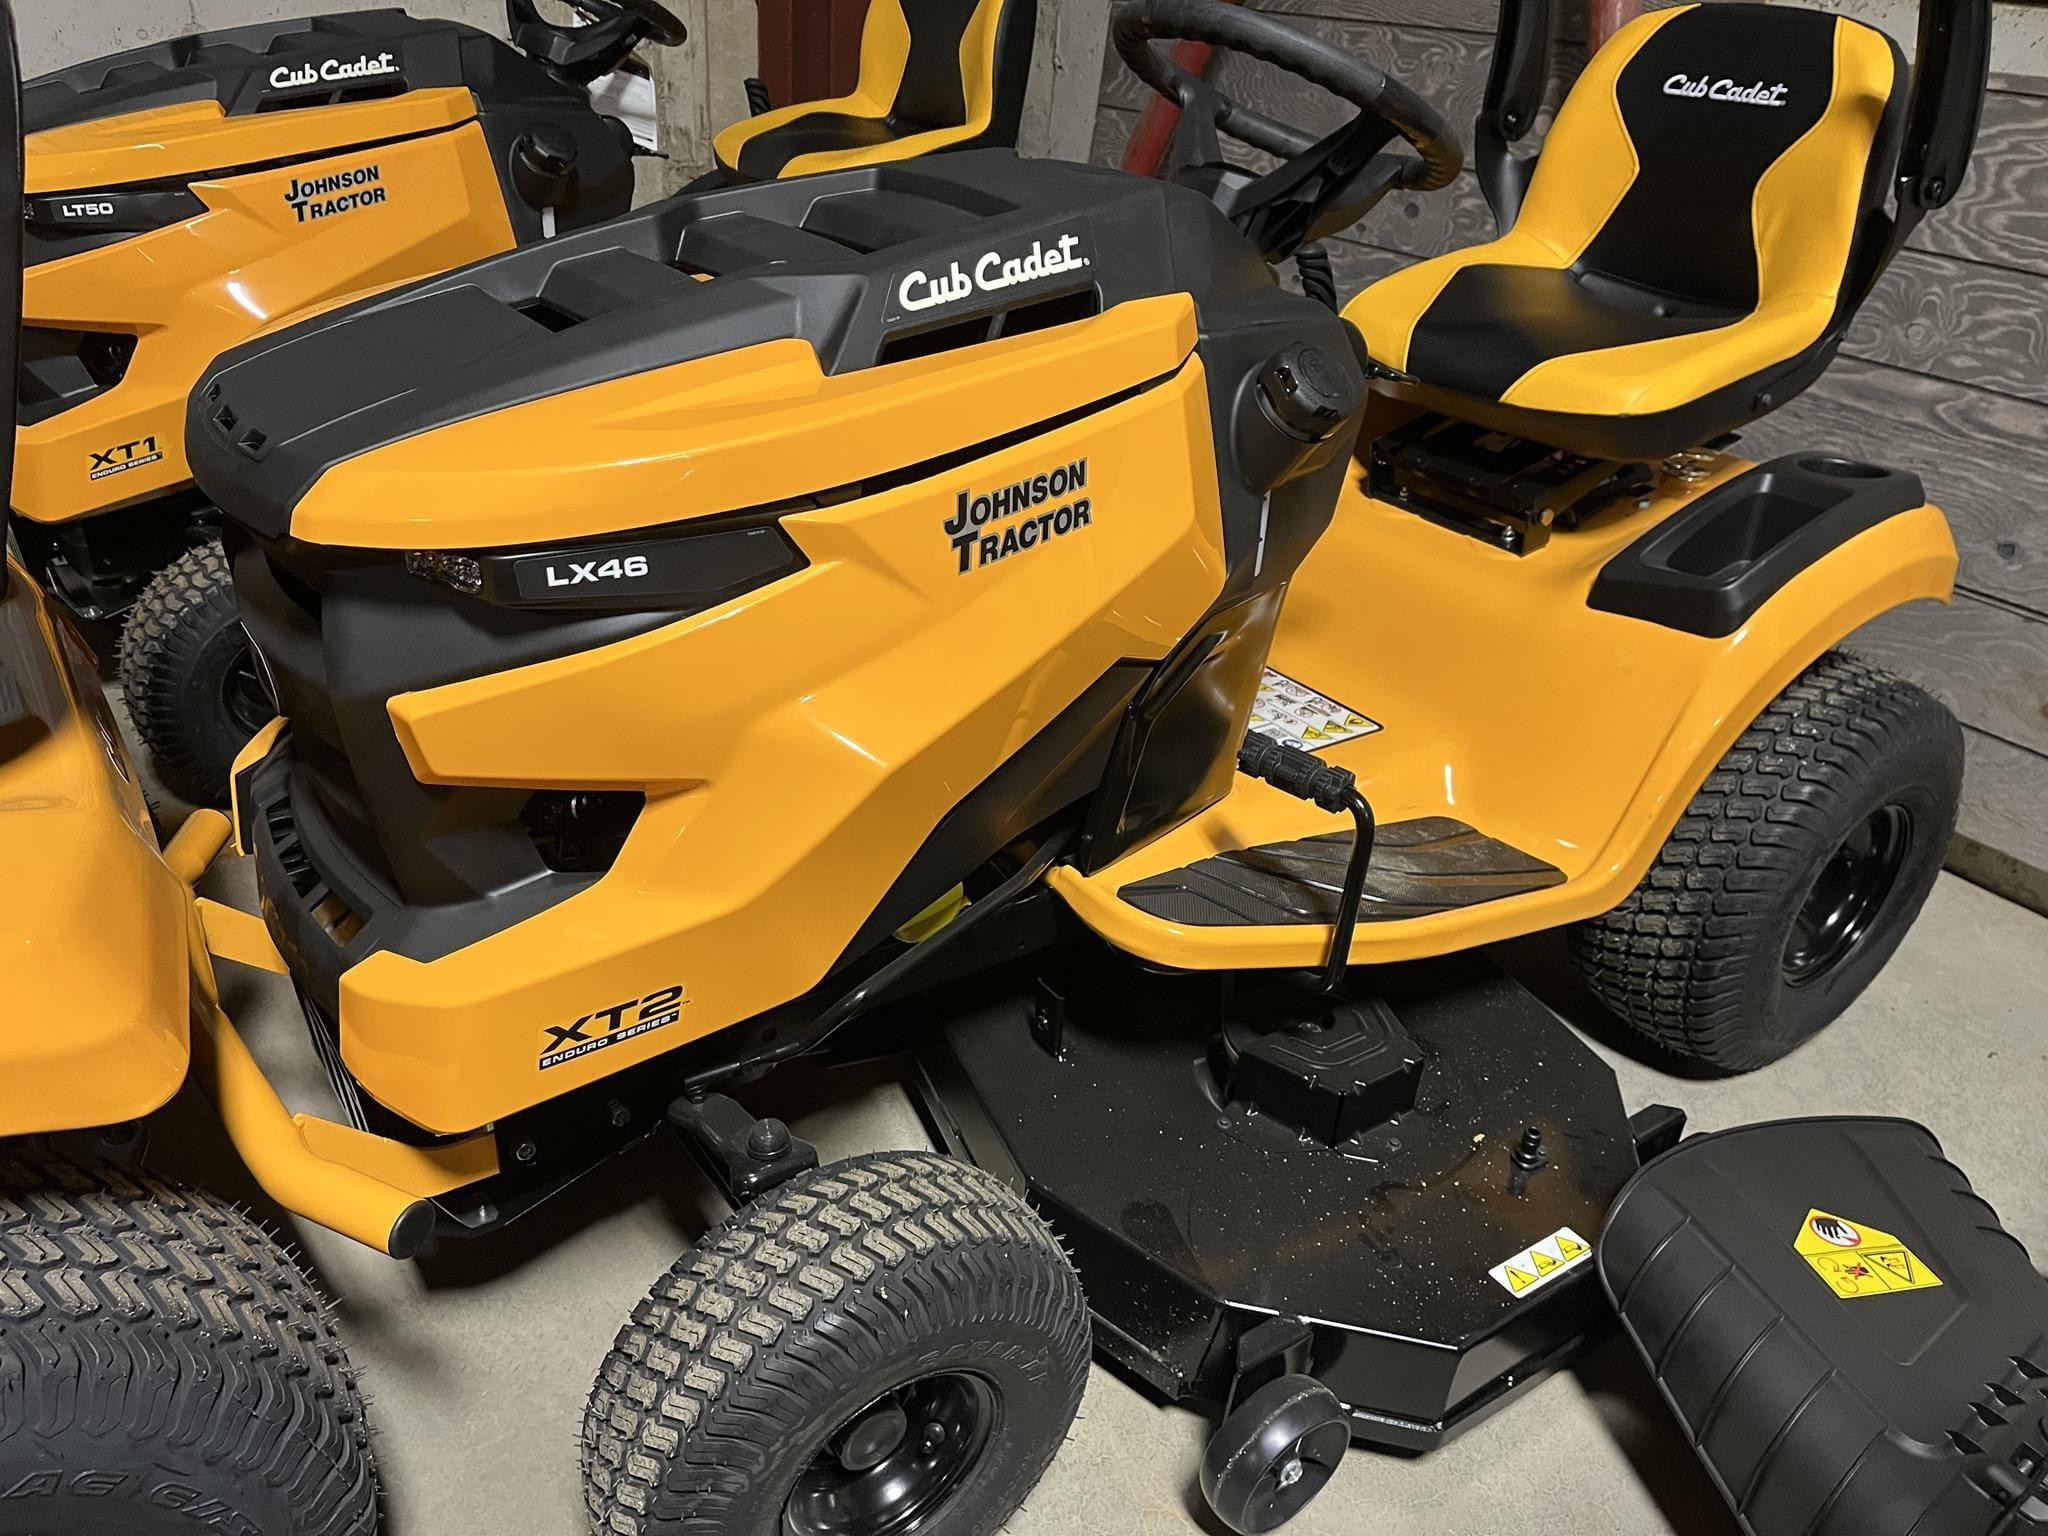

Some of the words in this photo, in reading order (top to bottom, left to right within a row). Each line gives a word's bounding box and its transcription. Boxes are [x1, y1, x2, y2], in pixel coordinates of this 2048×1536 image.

[269, 64, 319, 89] Cub
[320, 52, 395, 81] Cadet
[1663, 74, 1709, 98] Cub
[1708, 79, 1788, 107] Cadet
[284, 165, 380, 203] JOHNSON
[62, 202, 114, 217] LT50
[291, 187, 387, 223] TRACTOR
[899, 261, 973, 312] Cub
[975, 233, 1083, 291] Cadet
[89, 436, 158, 471] XT1
[91, 464, 127, 479] ENDURO
[944, 459, 1087, 536] JOHNSON
[951, 499, 1091, 574] TRACTOR
[546, 555, 649, 587] LX46
[540, 985, 683, 1056] XT2
[541, 1037, 609, 1068] ENDURO
